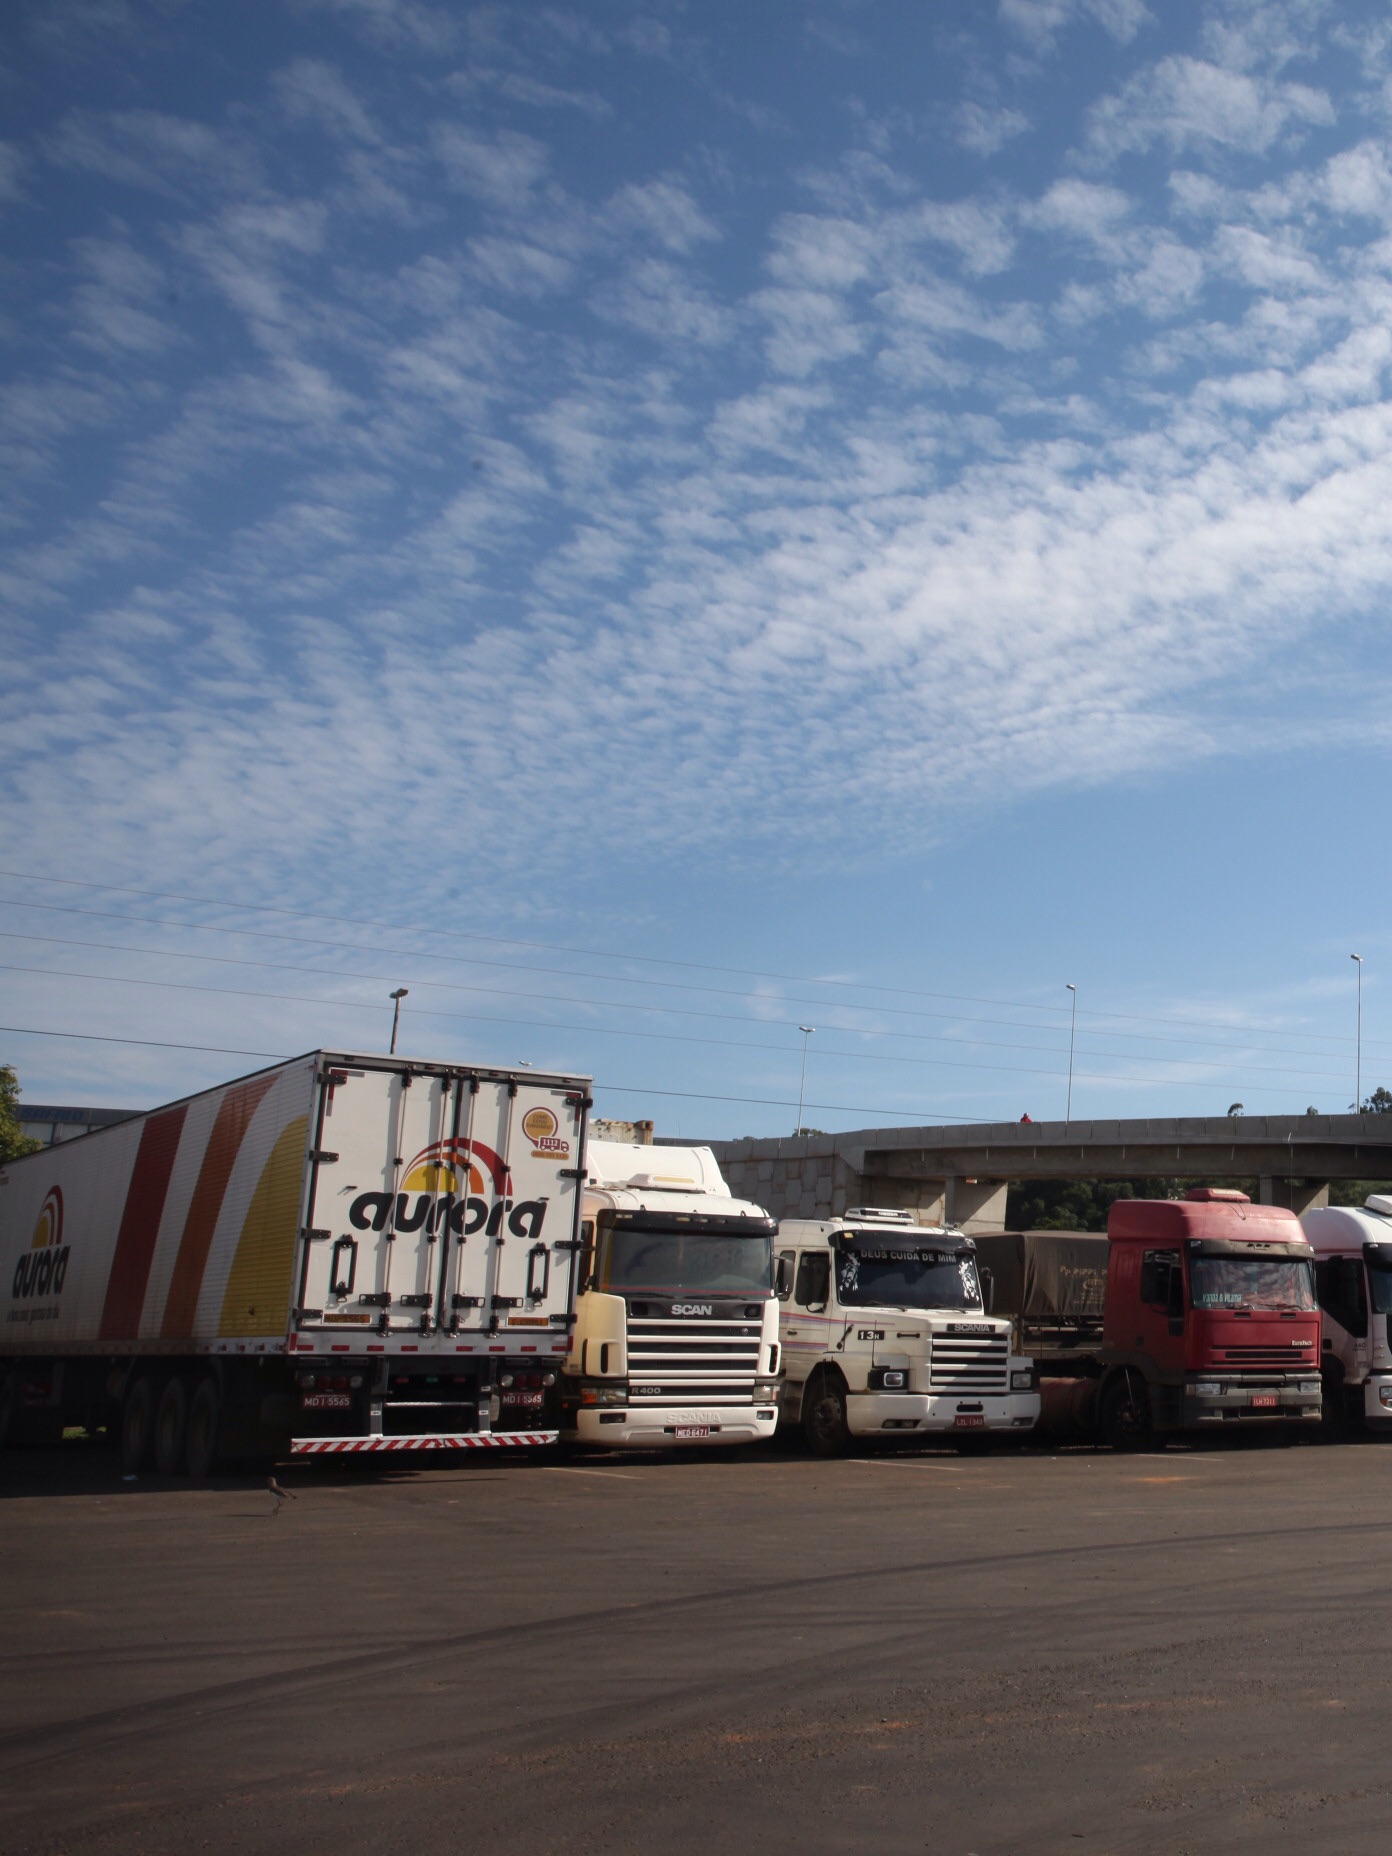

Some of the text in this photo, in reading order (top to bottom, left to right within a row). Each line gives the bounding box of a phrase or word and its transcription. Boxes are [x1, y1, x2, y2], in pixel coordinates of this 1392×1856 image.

[349, 1191, 547, 1238] aurora
[861, 1249, 956, 1263] DEUS CUIDA DE MIM
[13, 1246, 71, 1299] aurora
[671, 1304, 712, 1316] SCAN
[954, 1324, 990, 1332] SCANIA
[665, 1412, 721, 1424] SCANIA
